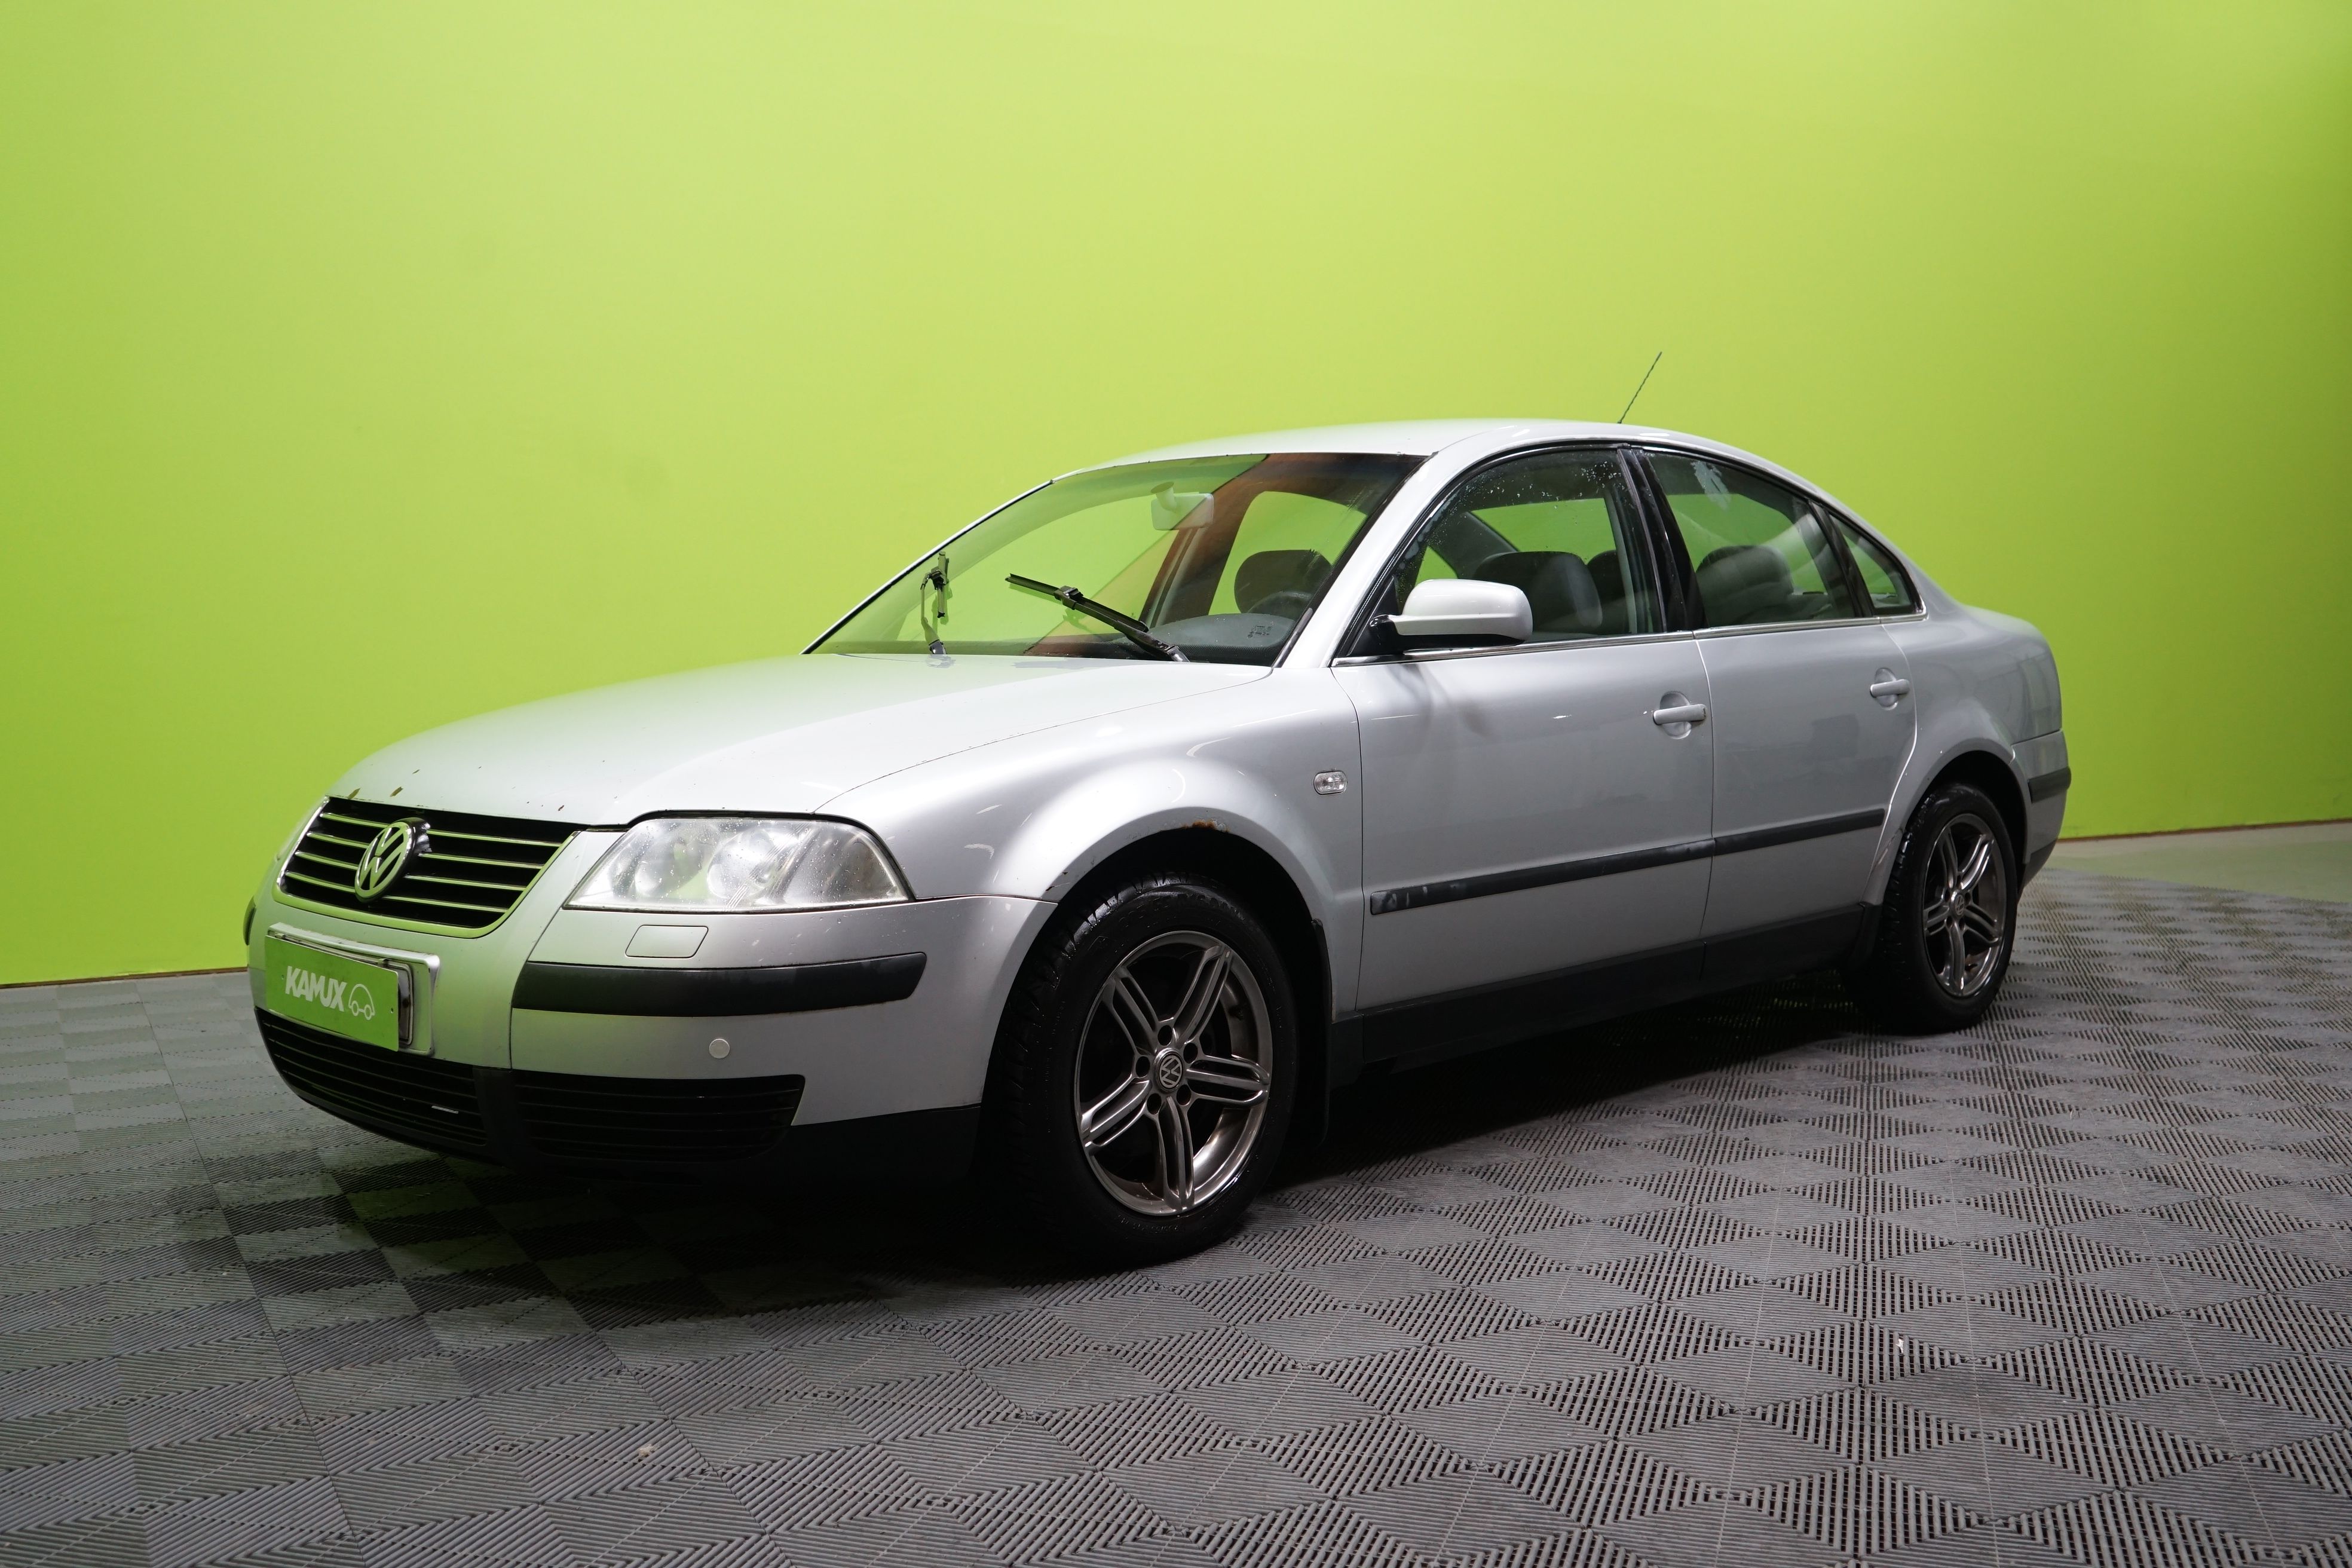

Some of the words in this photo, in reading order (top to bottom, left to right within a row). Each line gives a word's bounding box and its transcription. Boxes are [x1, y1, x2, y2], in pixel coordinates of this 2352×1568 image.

[355, 822, 412, 898] VW
[285, 966, 347, 1012] KAMUX
[1159, 1055, 1183, 1088] VW
